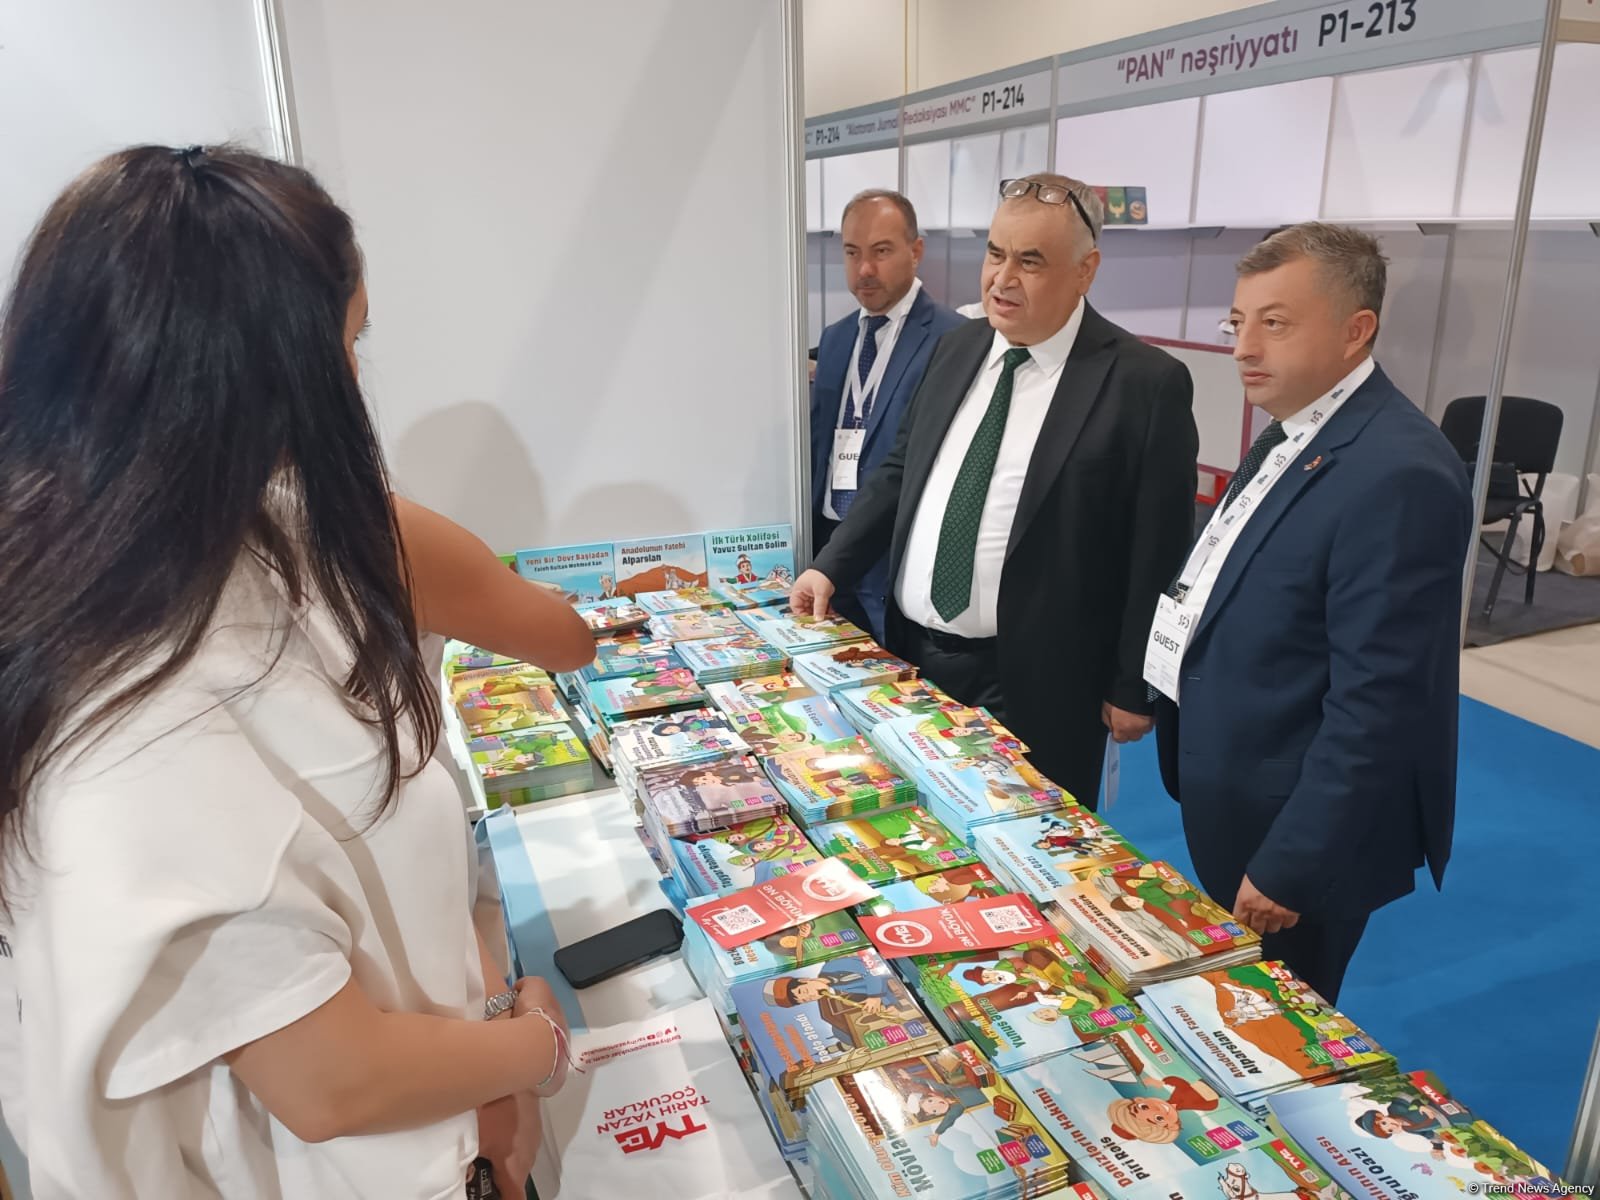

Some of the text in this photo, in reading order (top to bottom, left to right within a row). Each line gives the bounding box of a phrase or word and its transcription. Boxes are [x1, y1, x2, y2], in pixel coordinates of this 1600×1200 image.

[1318, 0, 1417, 47] P1-213
[1181, 25, 1299, 78] nəşriyyatı
[982, 83, 1024, 114] P1-214
[838, 452, 860, 461] GUE
[713, 544, 736, 554] Yavuz
[725, 534, 745, 544] Türk
[622, 553, 662, 566] Alparslan
[1153, 630, 1180, 654] GUEST
[1077, 893, 1104, 917] Atatürk
[1120, 932, 1151, 957] Mustafa
[996, 1019, 1026, 1049] Yunus
[1171, 1004, 1202, 1038] Fatehi
[1196, 1030, 1246, 1079] Anadolunun
[1212, 1030, 1263, 1075] Alparslan
[603, 1086, 697, 1119] ÇOCUKLAR
[597, 1111, 658, 1135] YAZAN
[1036, 1087, 1133, 1188] Dənizlərin Hakimi
[1099, 1135, 1151, 1182] Piri Rəis
[1316, 1136, 1352, 1167] Atası
[1347, 1146, 1385, 1175] Qazi
